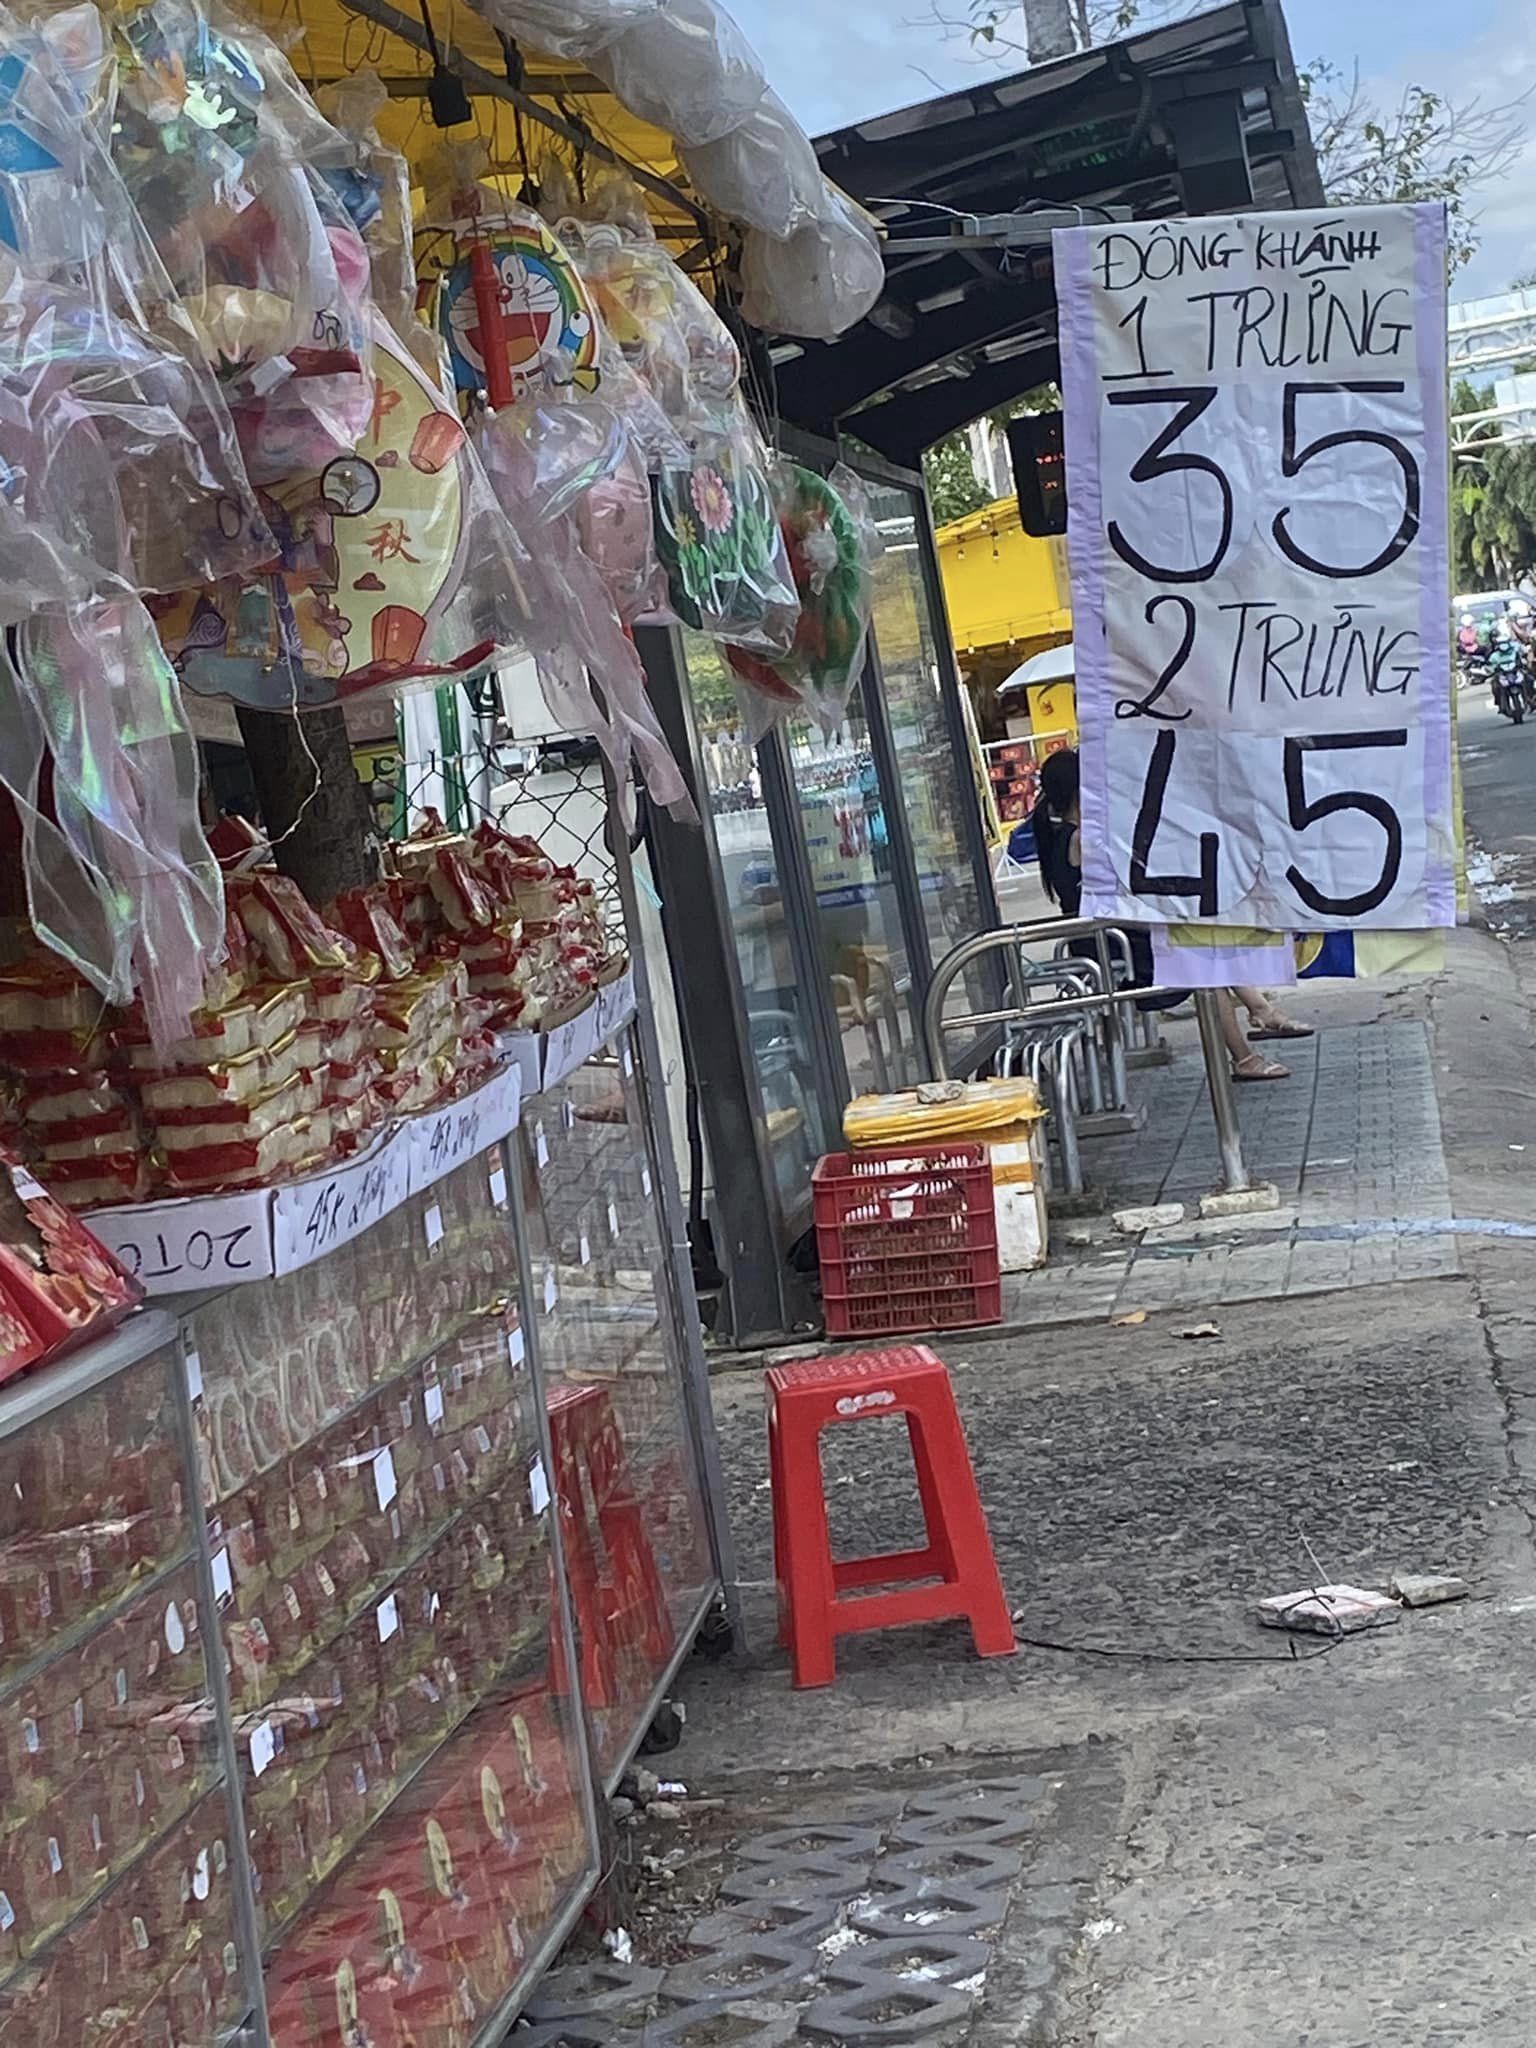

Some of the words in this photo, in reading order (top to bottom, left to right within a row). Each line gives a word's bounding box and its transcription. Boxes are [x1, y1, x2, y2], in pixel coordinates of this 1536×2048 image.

[1092, 220, 1245, 291] ĐỒNG
[1255, 218, 1382, 271] KHÁNH
[1101, 295, 1175, 381] 1
[1186, 266, 1413, 371] TRỨNG
[1106, 381, 1421, 584] 35
[1114, 593, 1196, 721] 2
[1217, 602, 1420, 713] TRỨNG
[1129, 728, 1409, 918] 45
